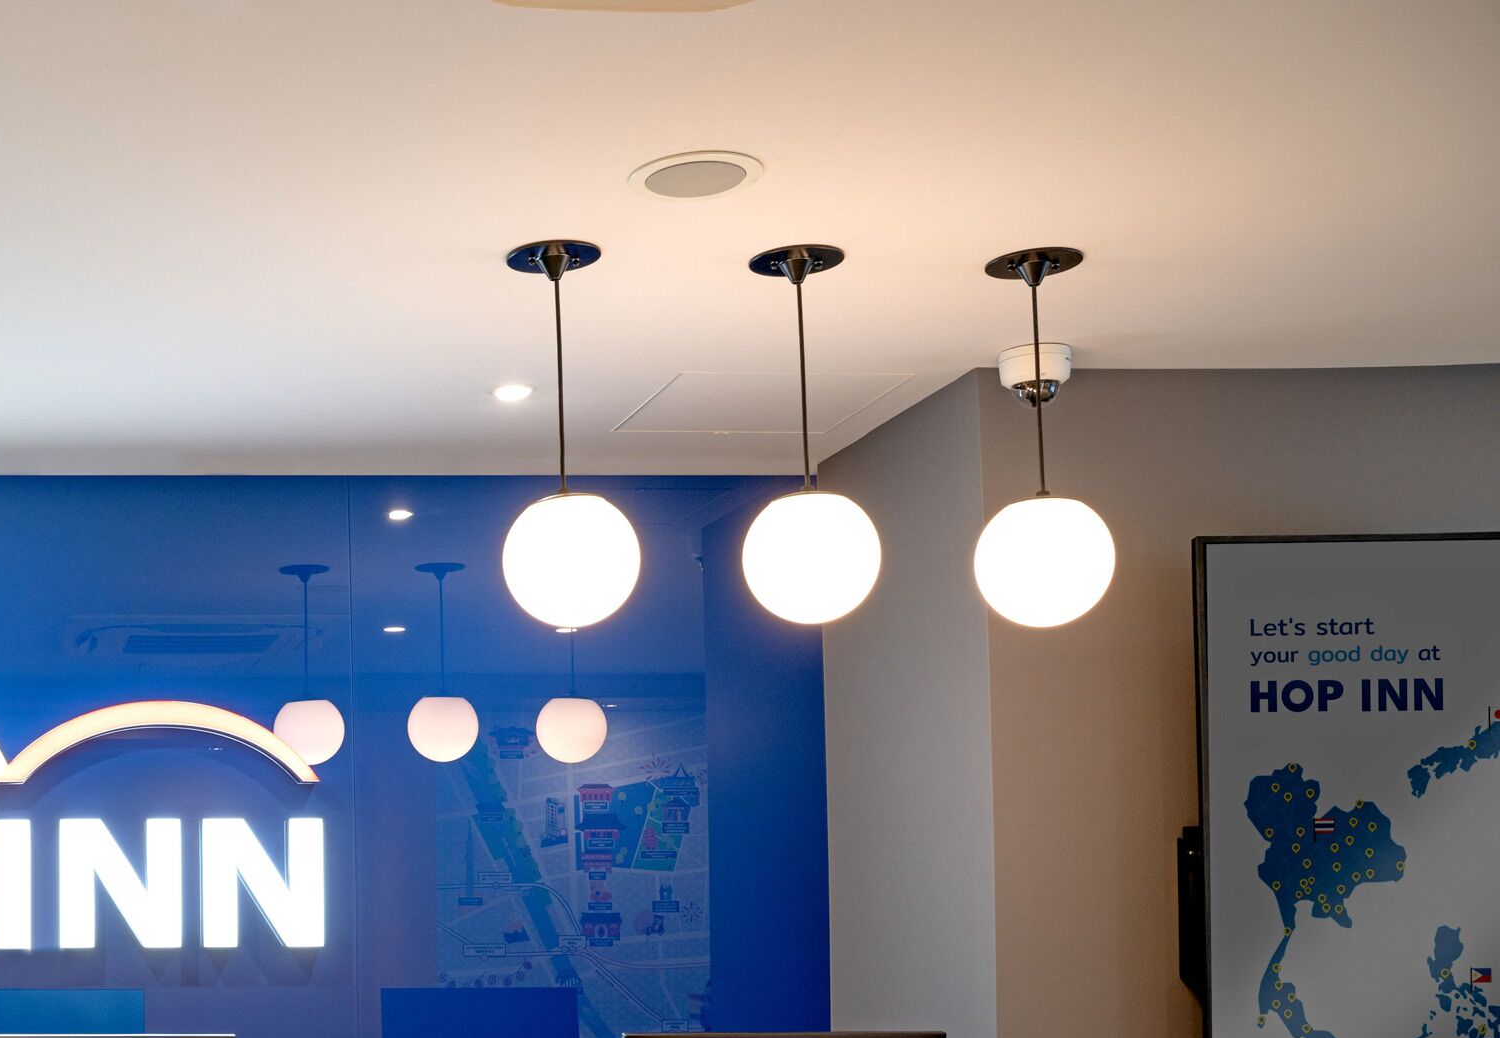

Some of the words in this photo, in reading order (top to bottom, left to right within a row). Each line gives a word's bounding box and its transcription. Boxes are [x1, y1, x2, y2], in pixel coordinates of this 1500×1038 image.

[1250, 618, 1306, 637] Let's
[1316, 618, 1375, 636] start
[1250, 650, 1299, 667] your
[1308, 645, 1361, 666] good
[1370, 645, 1409, 664] day
[1418, 645, 1441, 661] at
[1250, 679, 1344, 712] HOP
[1361, 678, 1444, 712] INN
